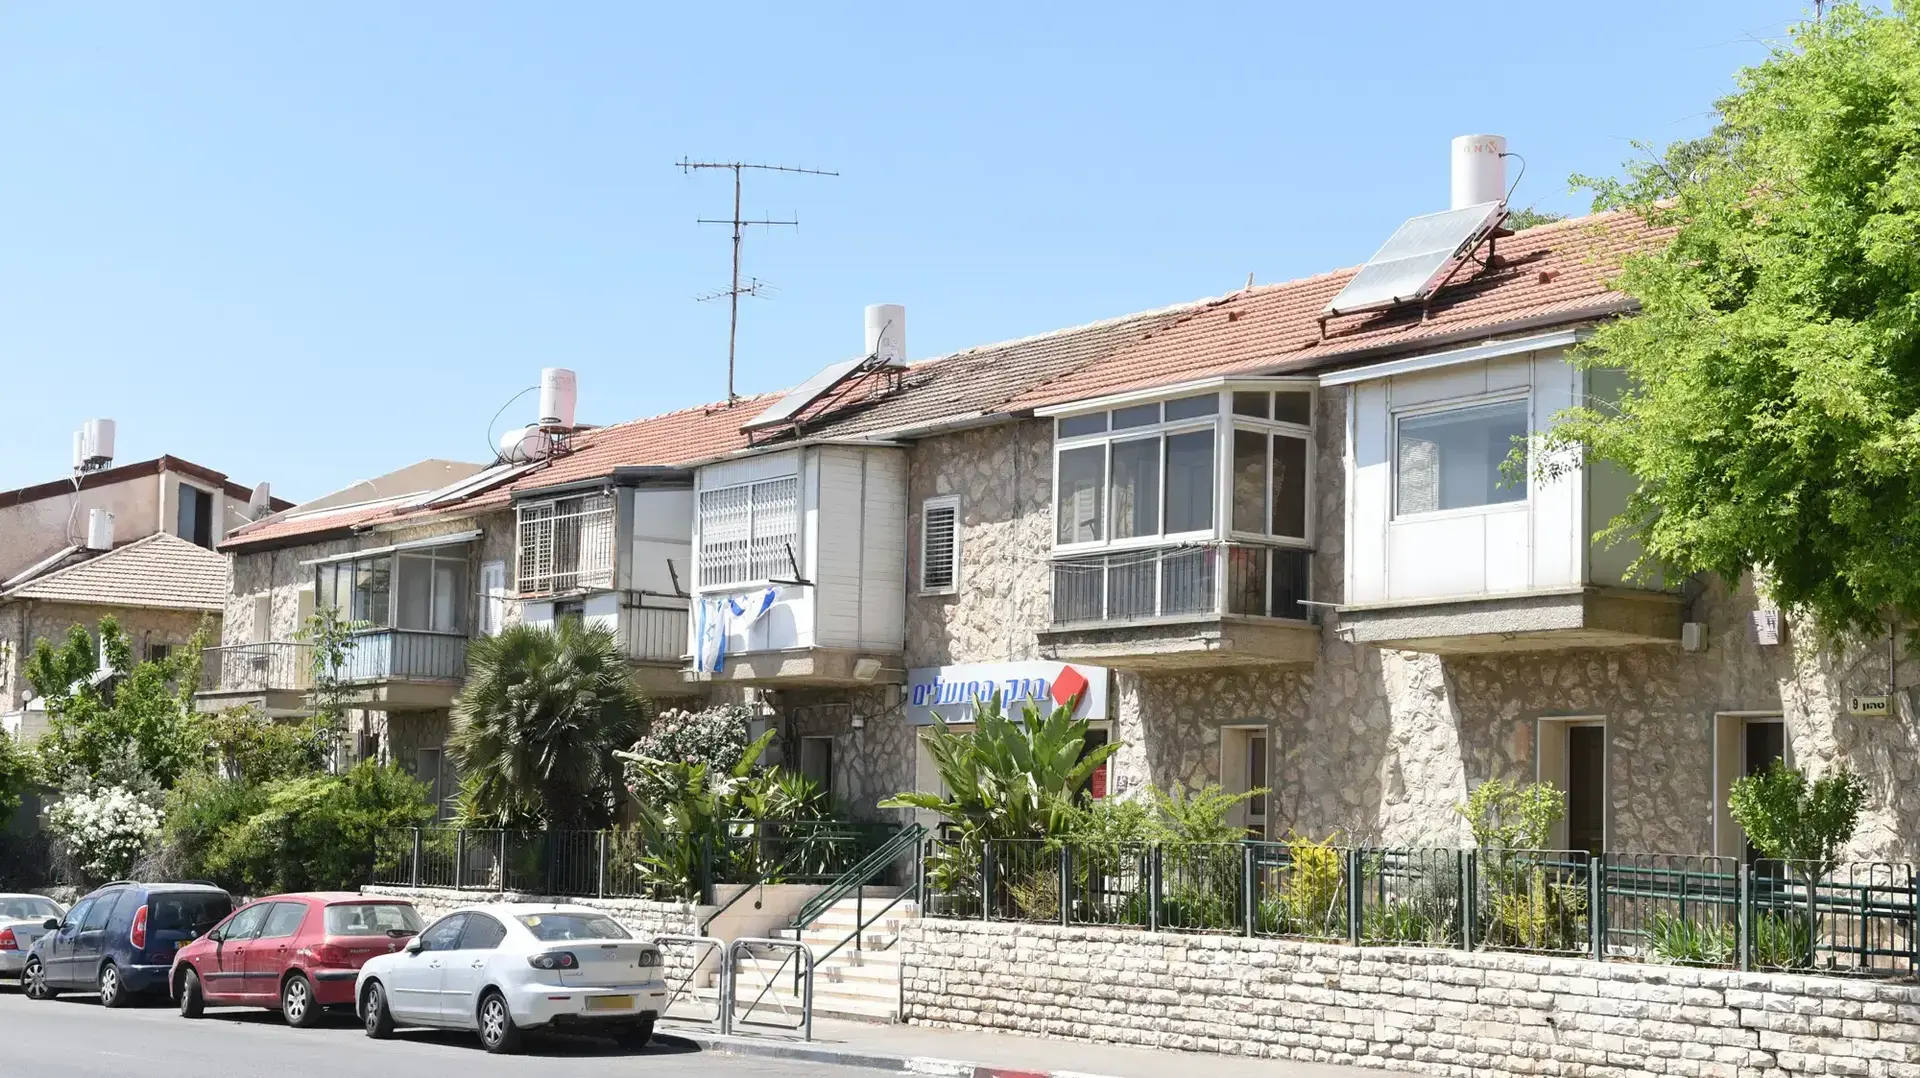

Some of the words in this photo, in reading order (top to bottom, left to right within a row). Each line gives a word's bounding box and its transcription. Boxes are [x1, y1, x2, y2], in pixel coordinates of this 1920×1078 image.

[912, 675, 996, 706] הפועלים
[1002, 678, 1048, 709] בנק
[1852, 698, 1859, 710] 9
[1862, 702, 1885, 711] טהון
